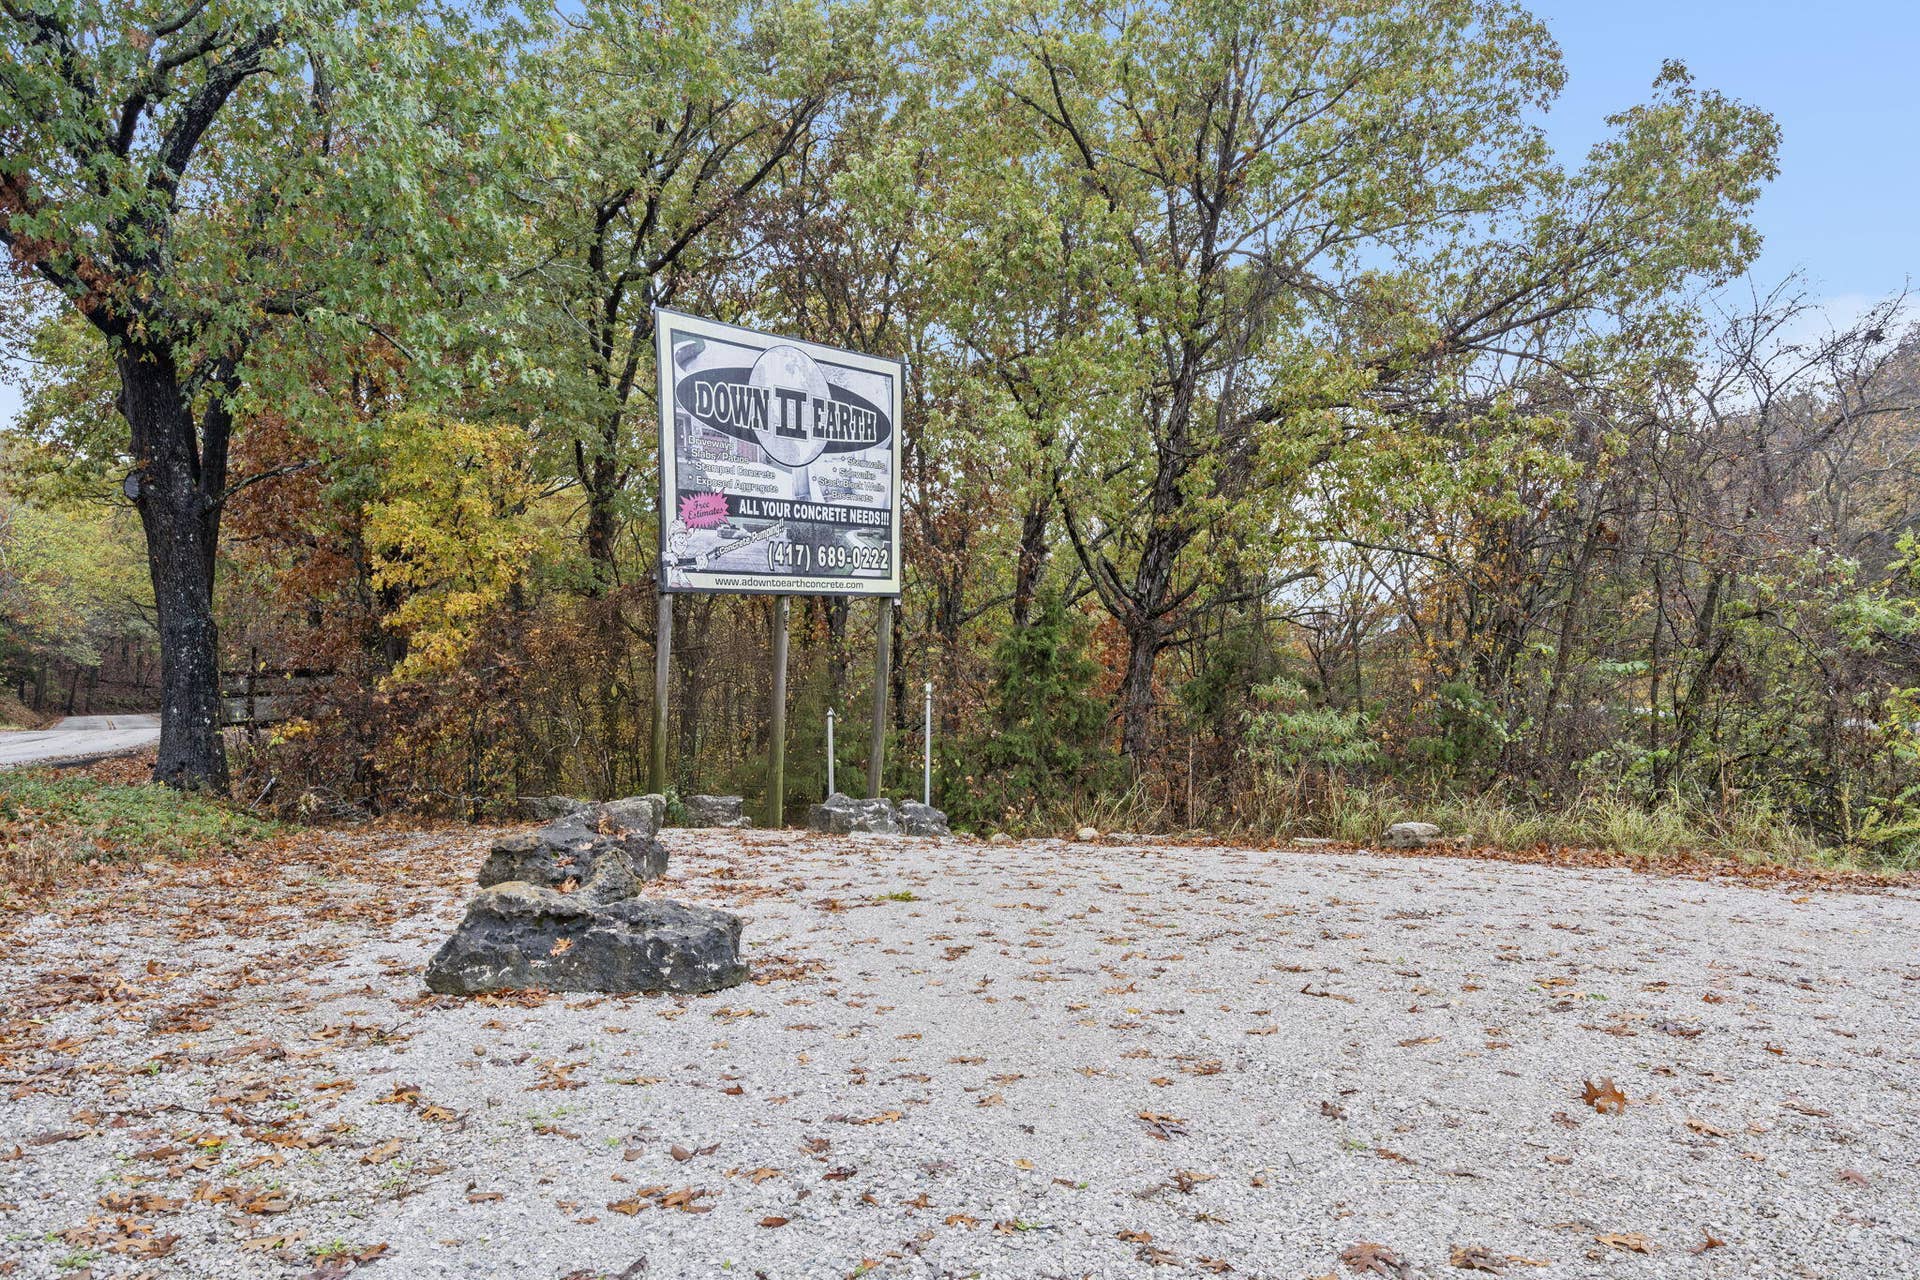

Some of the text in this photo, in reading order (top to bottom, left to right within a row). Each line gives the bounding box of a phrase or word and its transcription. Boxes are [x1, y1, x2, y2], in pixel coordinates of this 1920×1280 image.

[695, 381, 877, 442] DOWN II EARTH
[688, 435, 734, 450] Driveways
[695, 461, 776, 480] Stamped Concrete
[696, 475, 779, 494] Exposed Aggregate
[693, 500, 710, 511] Free
[831, 490, 874, 503] Basements
[688, 507, 724, 520] Estimates
[739, 499, 890, 526] ALL YOUR CONCRETE NEEDS!!!
[719, 536, 751, 556] Concrete
[768, 541, 889, 572] (417) 689-0222
[714, 576, 864, 590] www.adowntoearthconcrete.com
